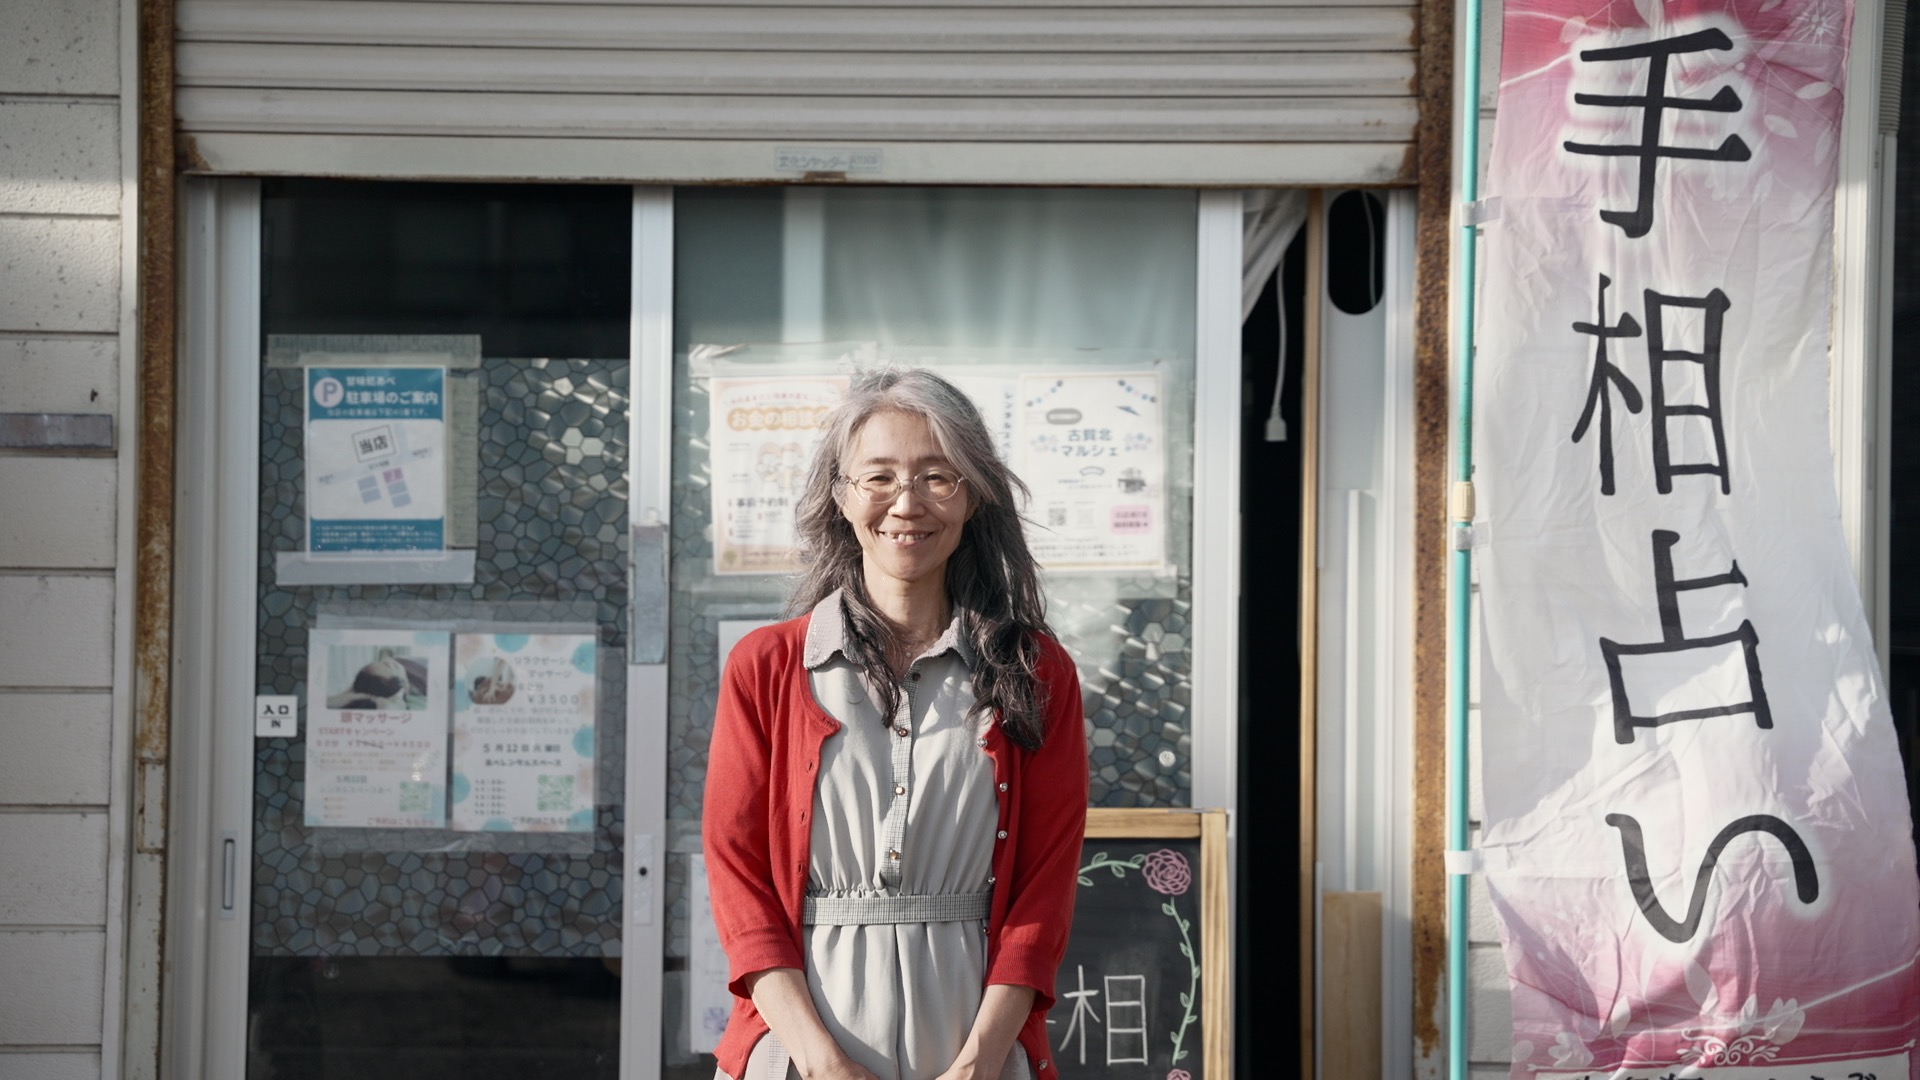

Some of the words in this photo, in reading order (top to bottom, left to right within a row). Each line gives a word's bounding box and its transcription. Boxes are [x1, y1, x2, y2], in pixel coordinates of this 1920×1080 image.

[322, 381, 338, 403] P
[346, 390, 438, 405] 駐車場のご案内
[358, 434, 389, 456] 当店
[1061, 444, 1120, 457] マルシェ
[1563, 26, 1819, 944] 手相占い
[263, 704, 289, 716] 入口
[271, 720, 281, 728] IN
